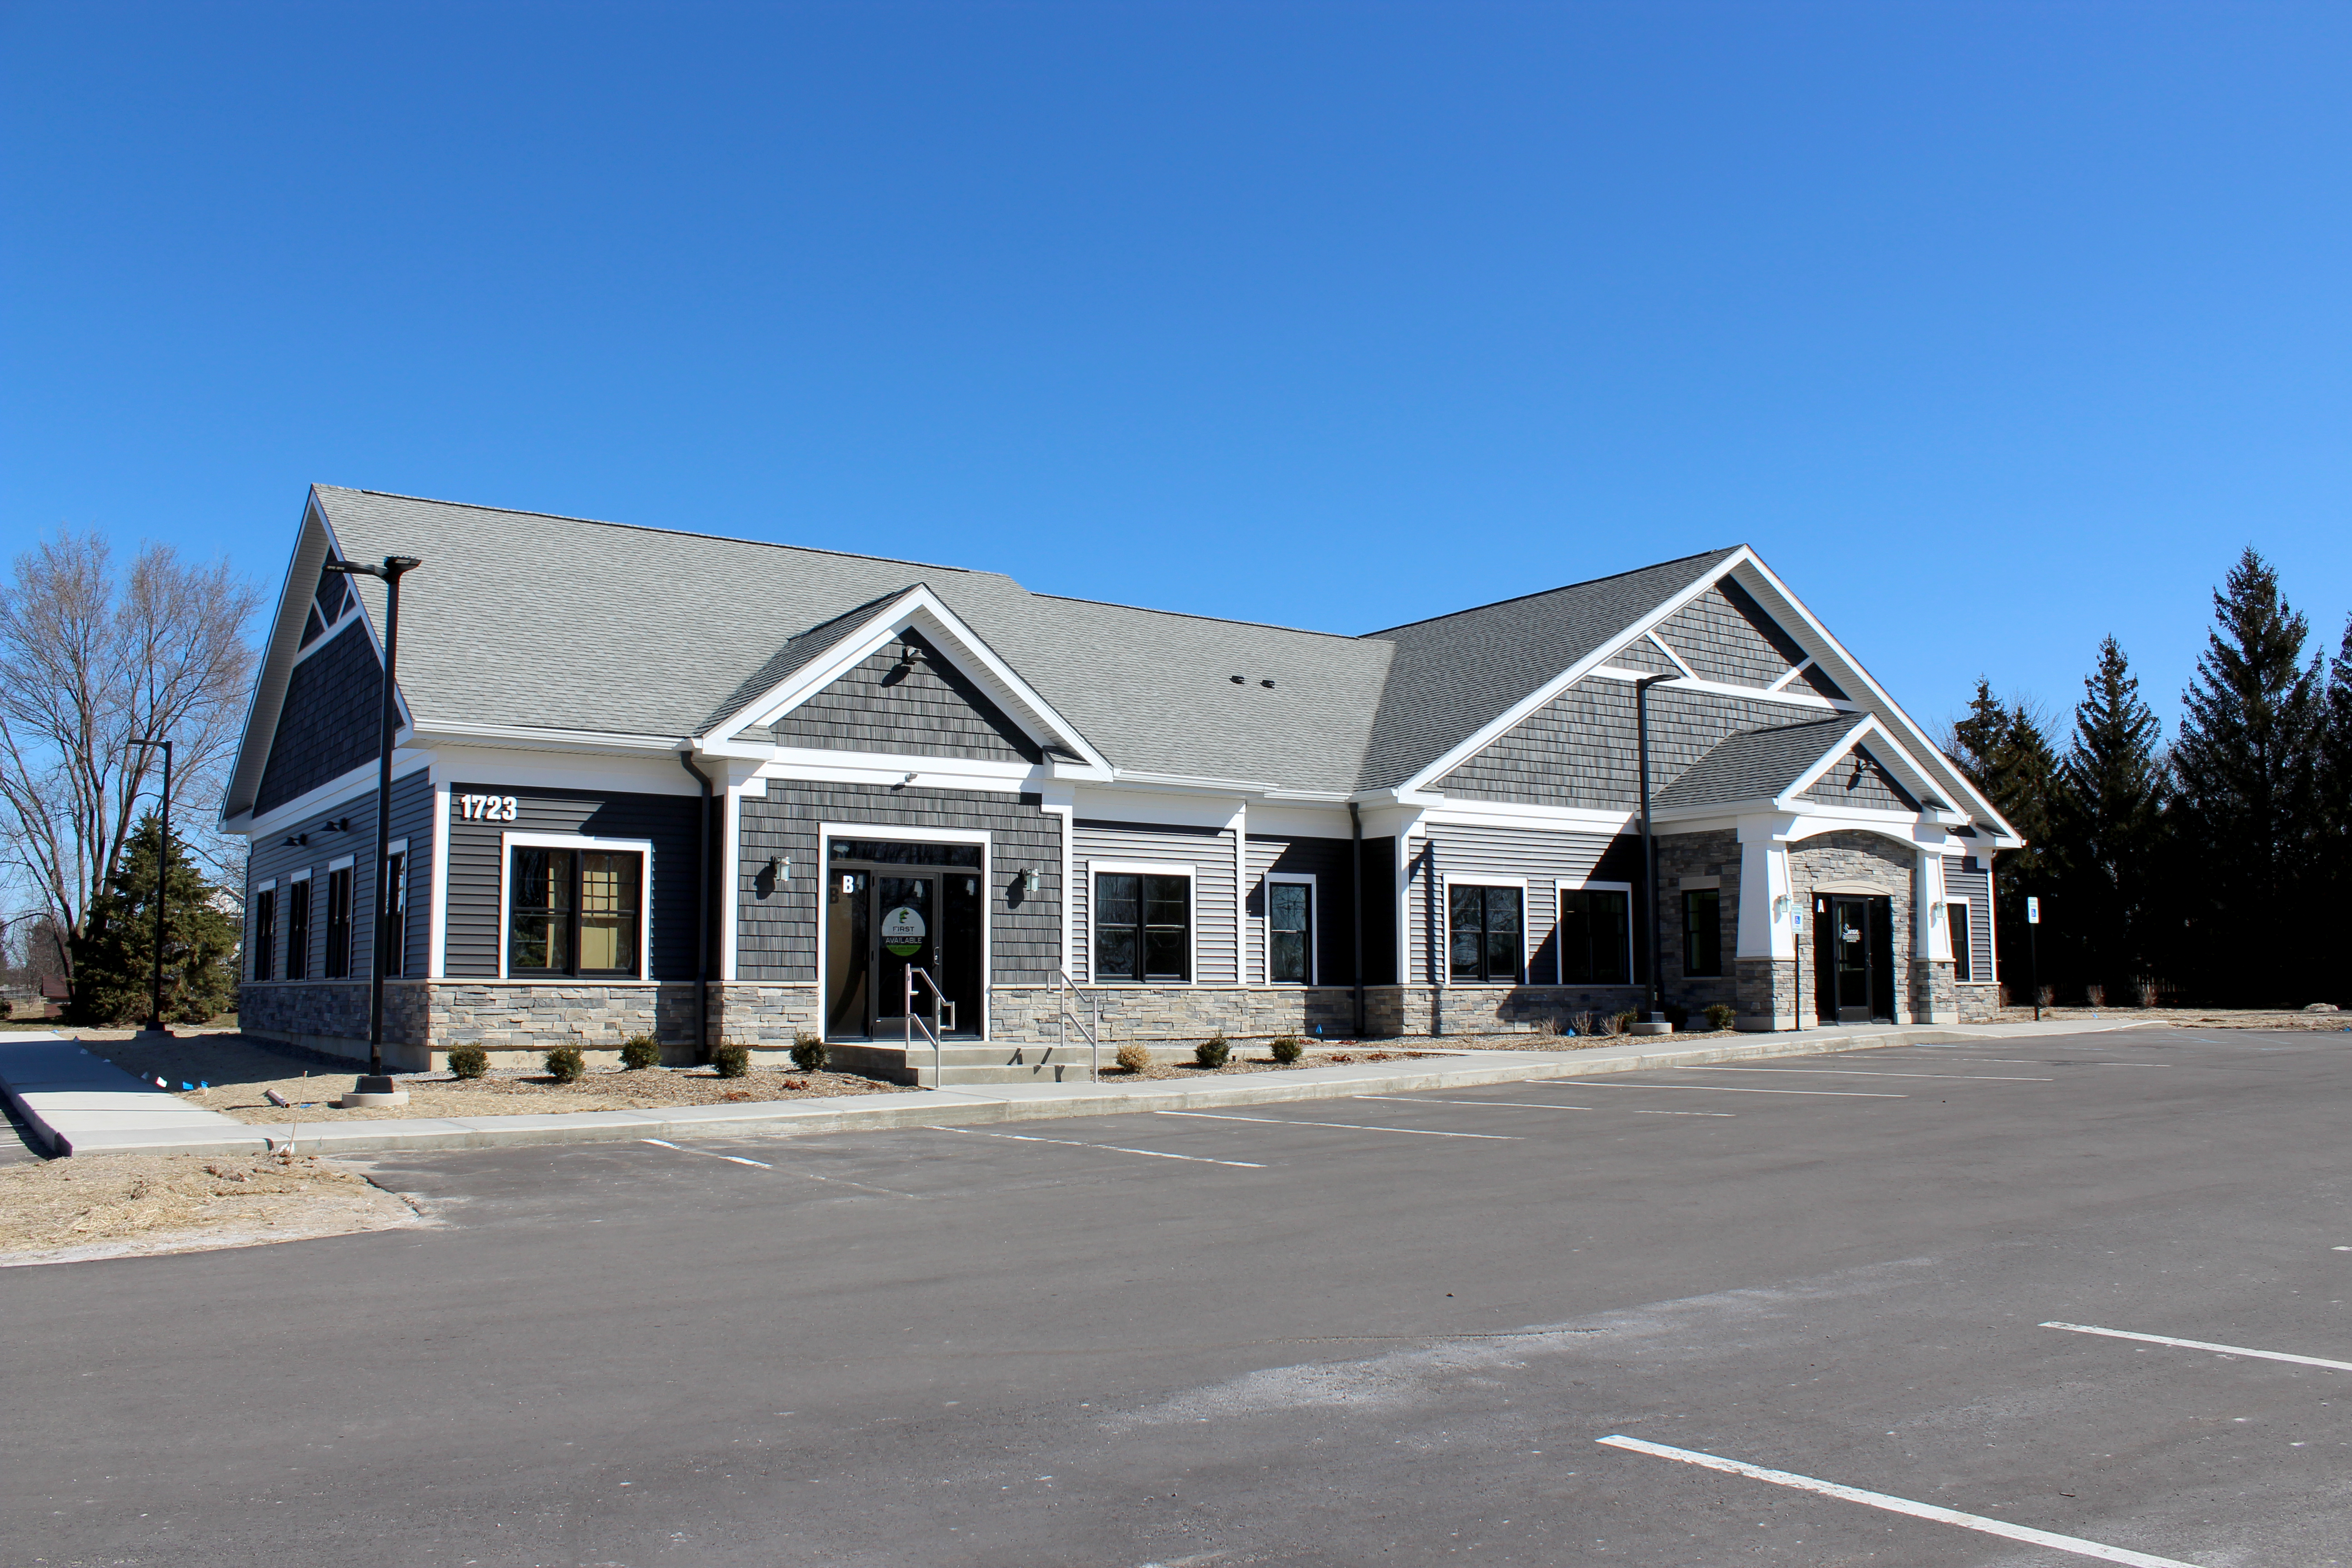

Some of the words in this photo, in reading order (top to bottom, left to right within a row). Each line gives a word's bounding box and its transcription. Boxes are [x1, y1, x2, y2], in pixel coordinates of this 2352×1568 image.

[461, 794, 517, 821] 1723
[843, 875, 854, 893] B
[1817, 899, 1825, 912] A
